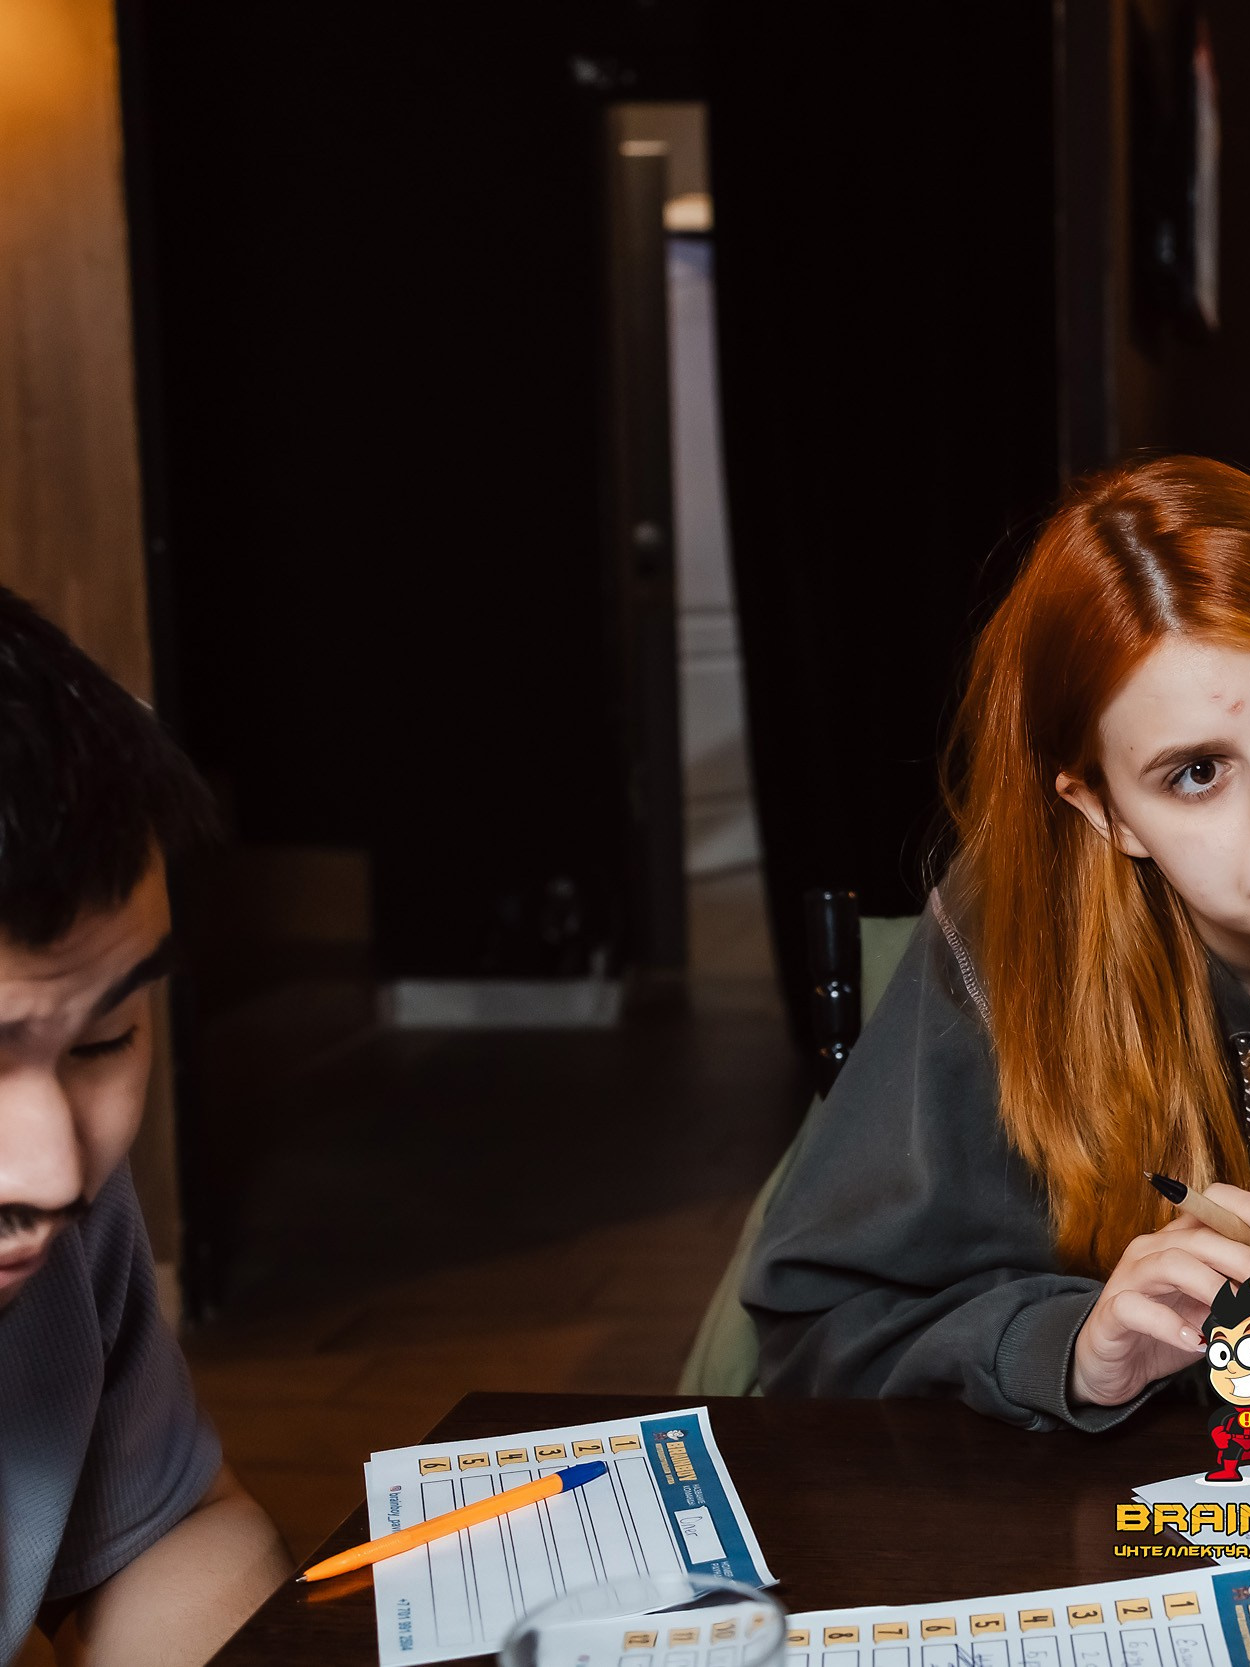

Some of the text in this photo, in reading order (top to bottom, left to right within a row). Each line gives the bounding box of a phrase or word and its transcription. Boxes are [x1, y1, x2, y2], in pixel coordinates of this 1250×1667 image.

[538, 1448, 562, 1456] 3
[462, 1457, 485, 1465] 5
[500, 1453, 523, 1461] 4
[1072, 1610, 1098, 1619] 3
[1123, 1606, 1148, 1615] 2
[1023, 1614, 1048, 1623] 4
[925, 1624, 951, 1632] 6
[975, 1620, 1000, 1629] 5
[828, 1632, 854, 1640] 8
